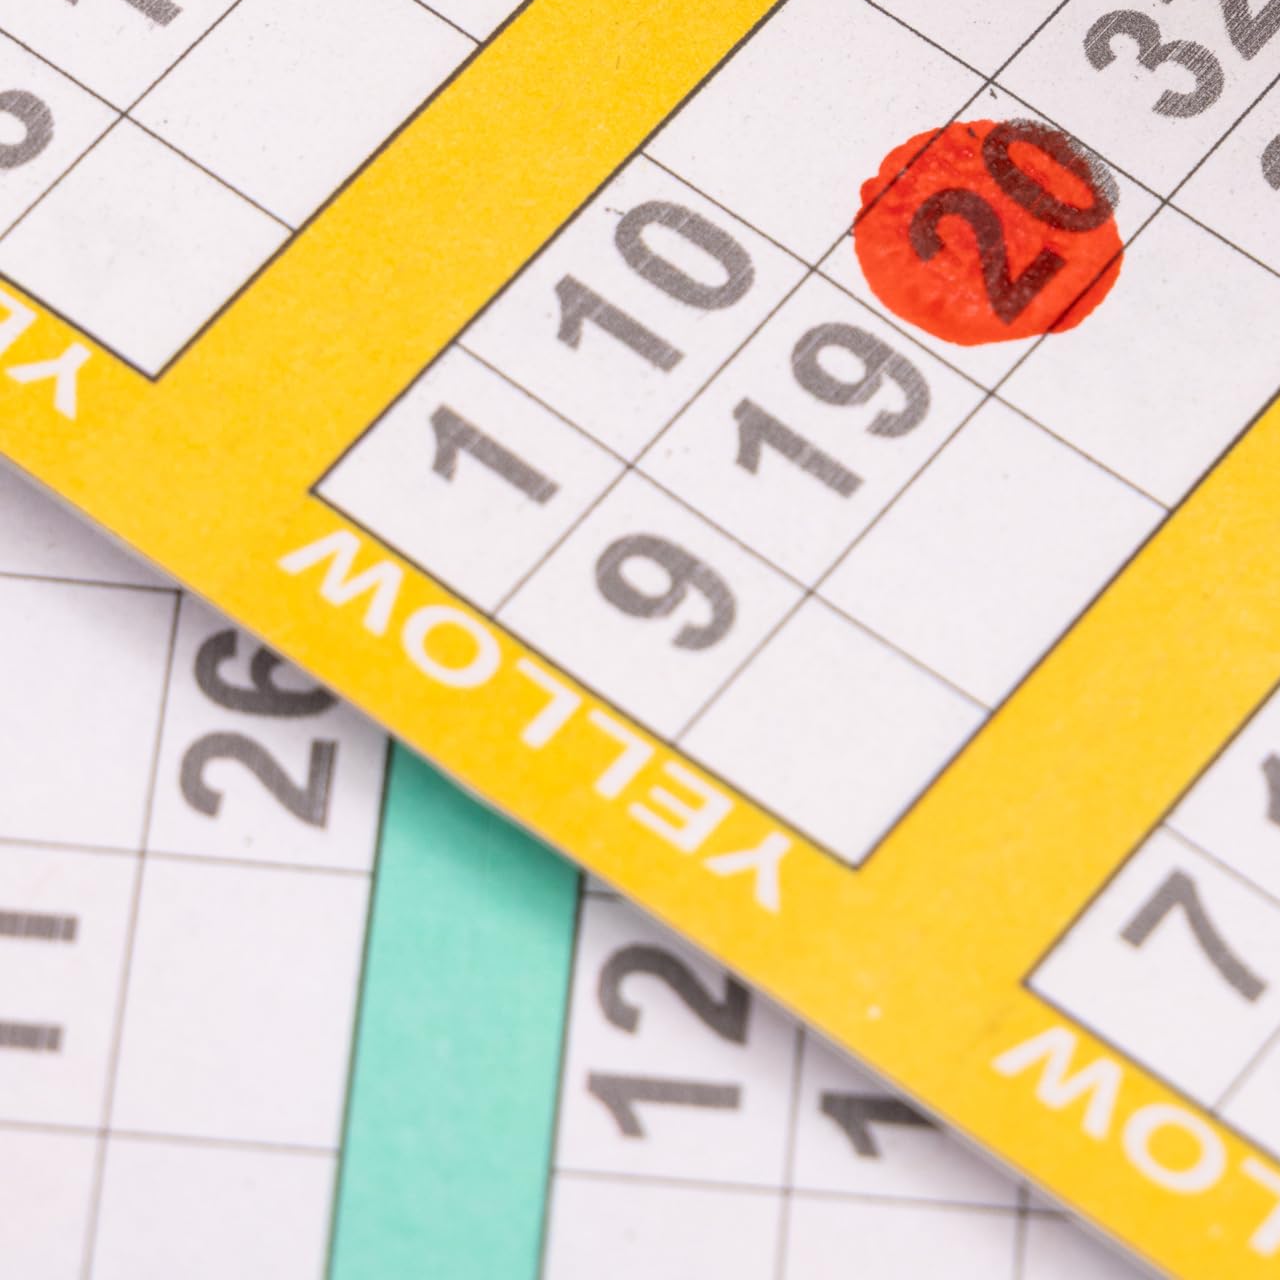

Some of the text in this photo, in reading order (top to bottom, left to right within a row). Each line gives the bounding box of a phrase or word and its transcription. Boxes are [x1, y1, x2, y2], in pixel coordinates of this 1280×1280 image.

[554, 200, 756, 372] 10
[908, 118, 1120, 325] 20
[430, 404, 560, 505] 1
[733, 322, 931, 499] 19
[595, 532, 736, 651] 9
[180, 628, 340, 832] 26
[278, 529, 793, 911] YELLOW
[1119, 866, 1268, 1004] 7
[585, 942, 754, 1140] 12
